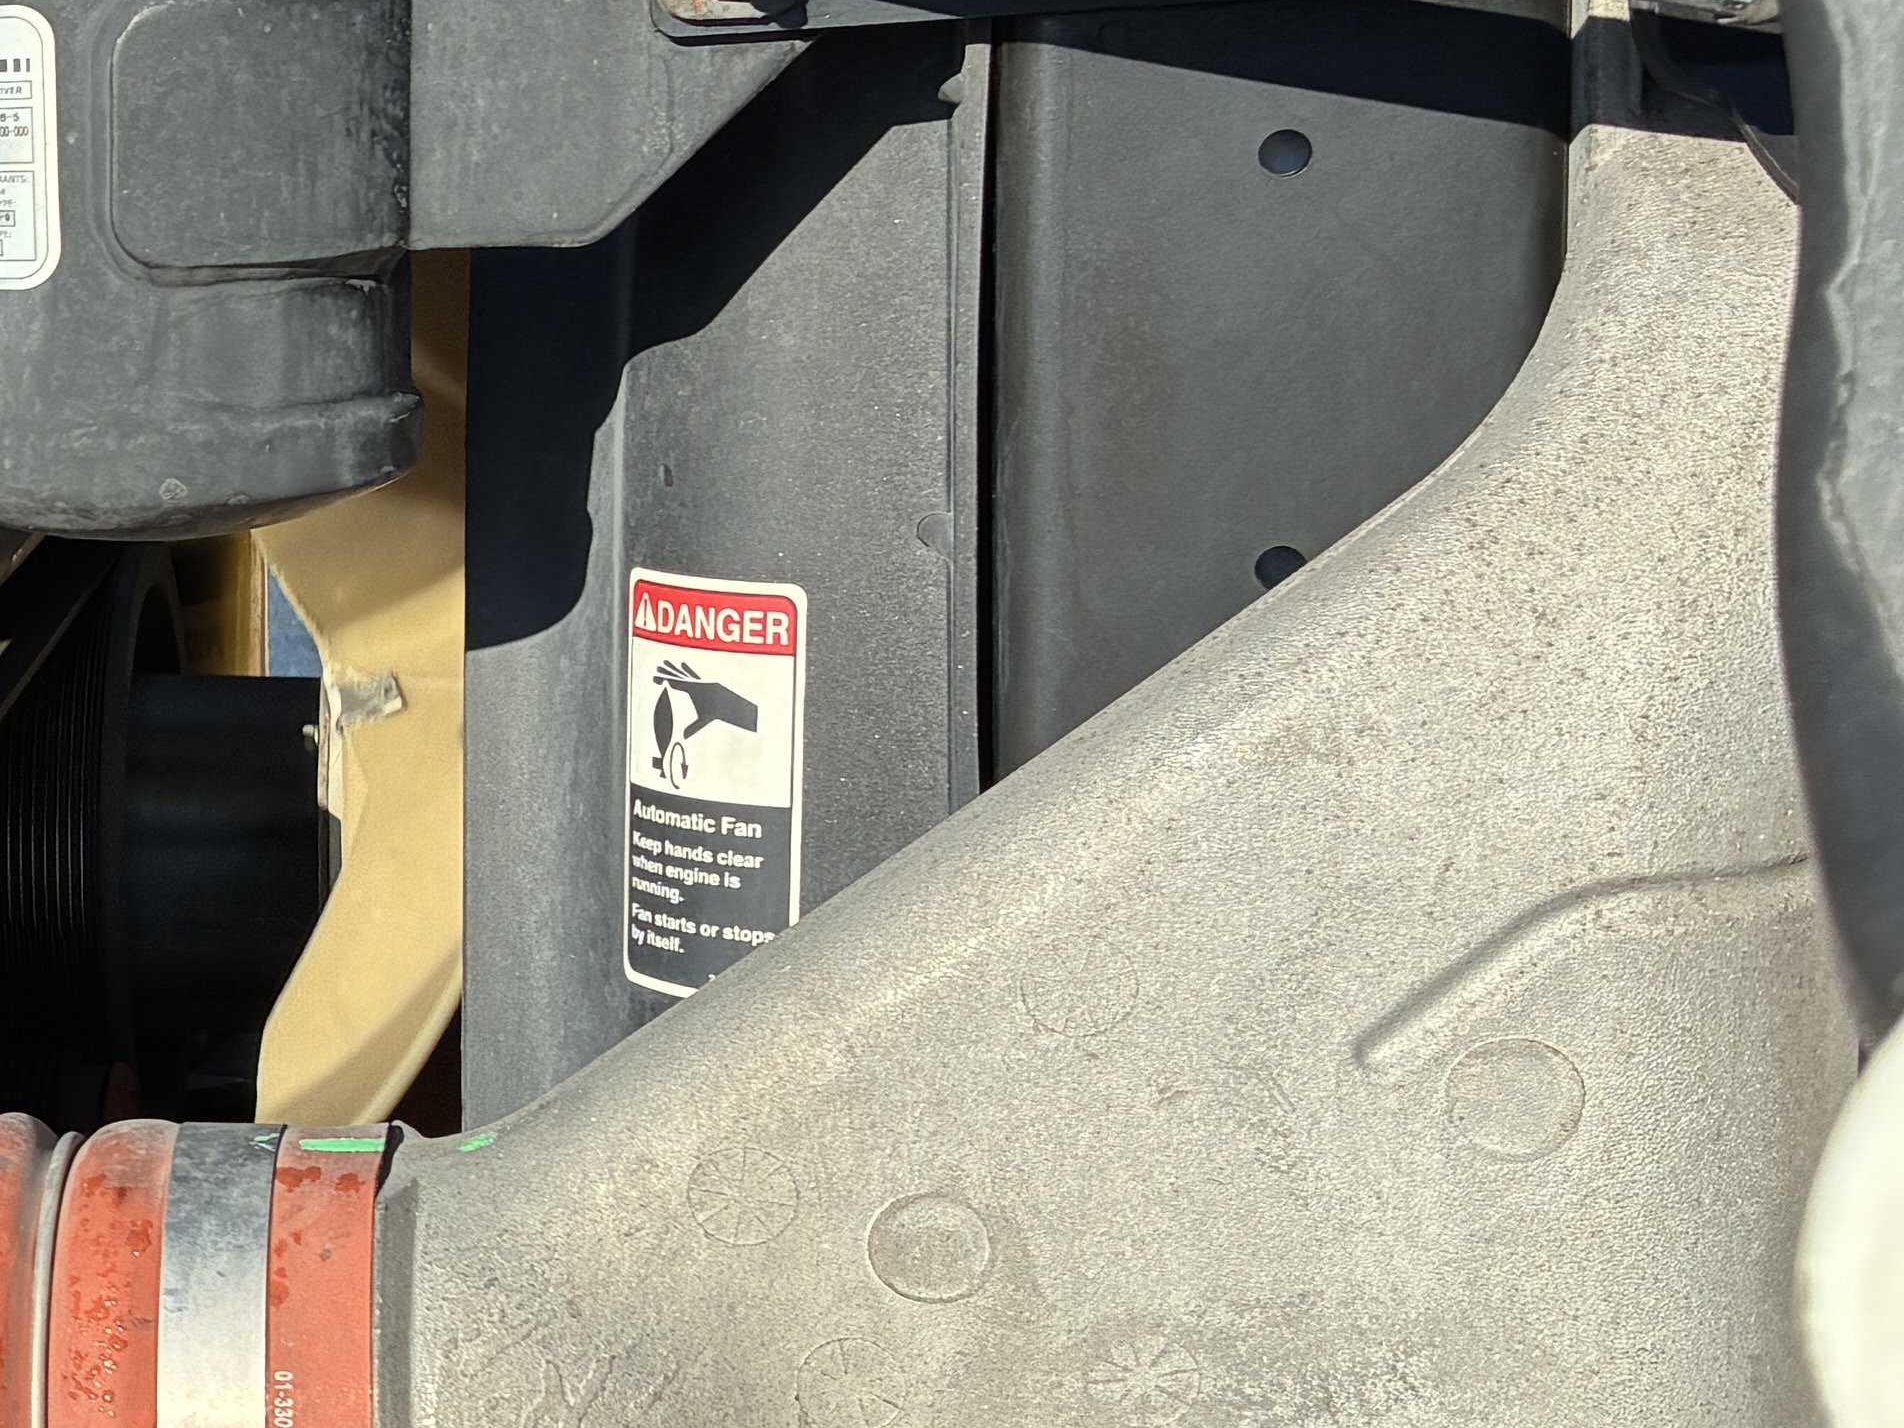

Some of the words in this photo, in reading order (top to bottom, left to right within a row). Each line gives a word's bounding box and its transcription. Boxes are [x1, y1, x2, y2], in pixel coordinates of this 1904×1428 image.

[656, 600, 790, 647] DANGER
[633, 800, 716, 834] Automatic
[722, 817, 763, 839] Fan
[633, 832, 662, 856] Keep
[664, 839, 713, 863] hands
[717, 847, 764, 869] clear
[632, 853, 663, 876] when
[665, 863, 721, 889] engine
[724, 869, 741, 888] is
[632, 876, 685, 904] running.
[632, 904, 653, 926] Fan
[654, 910, 697, 933] starts
[700, 922, 719, 937] or
[631, 926, 645, 946] by
[647, 930, 685, 954] itself.
